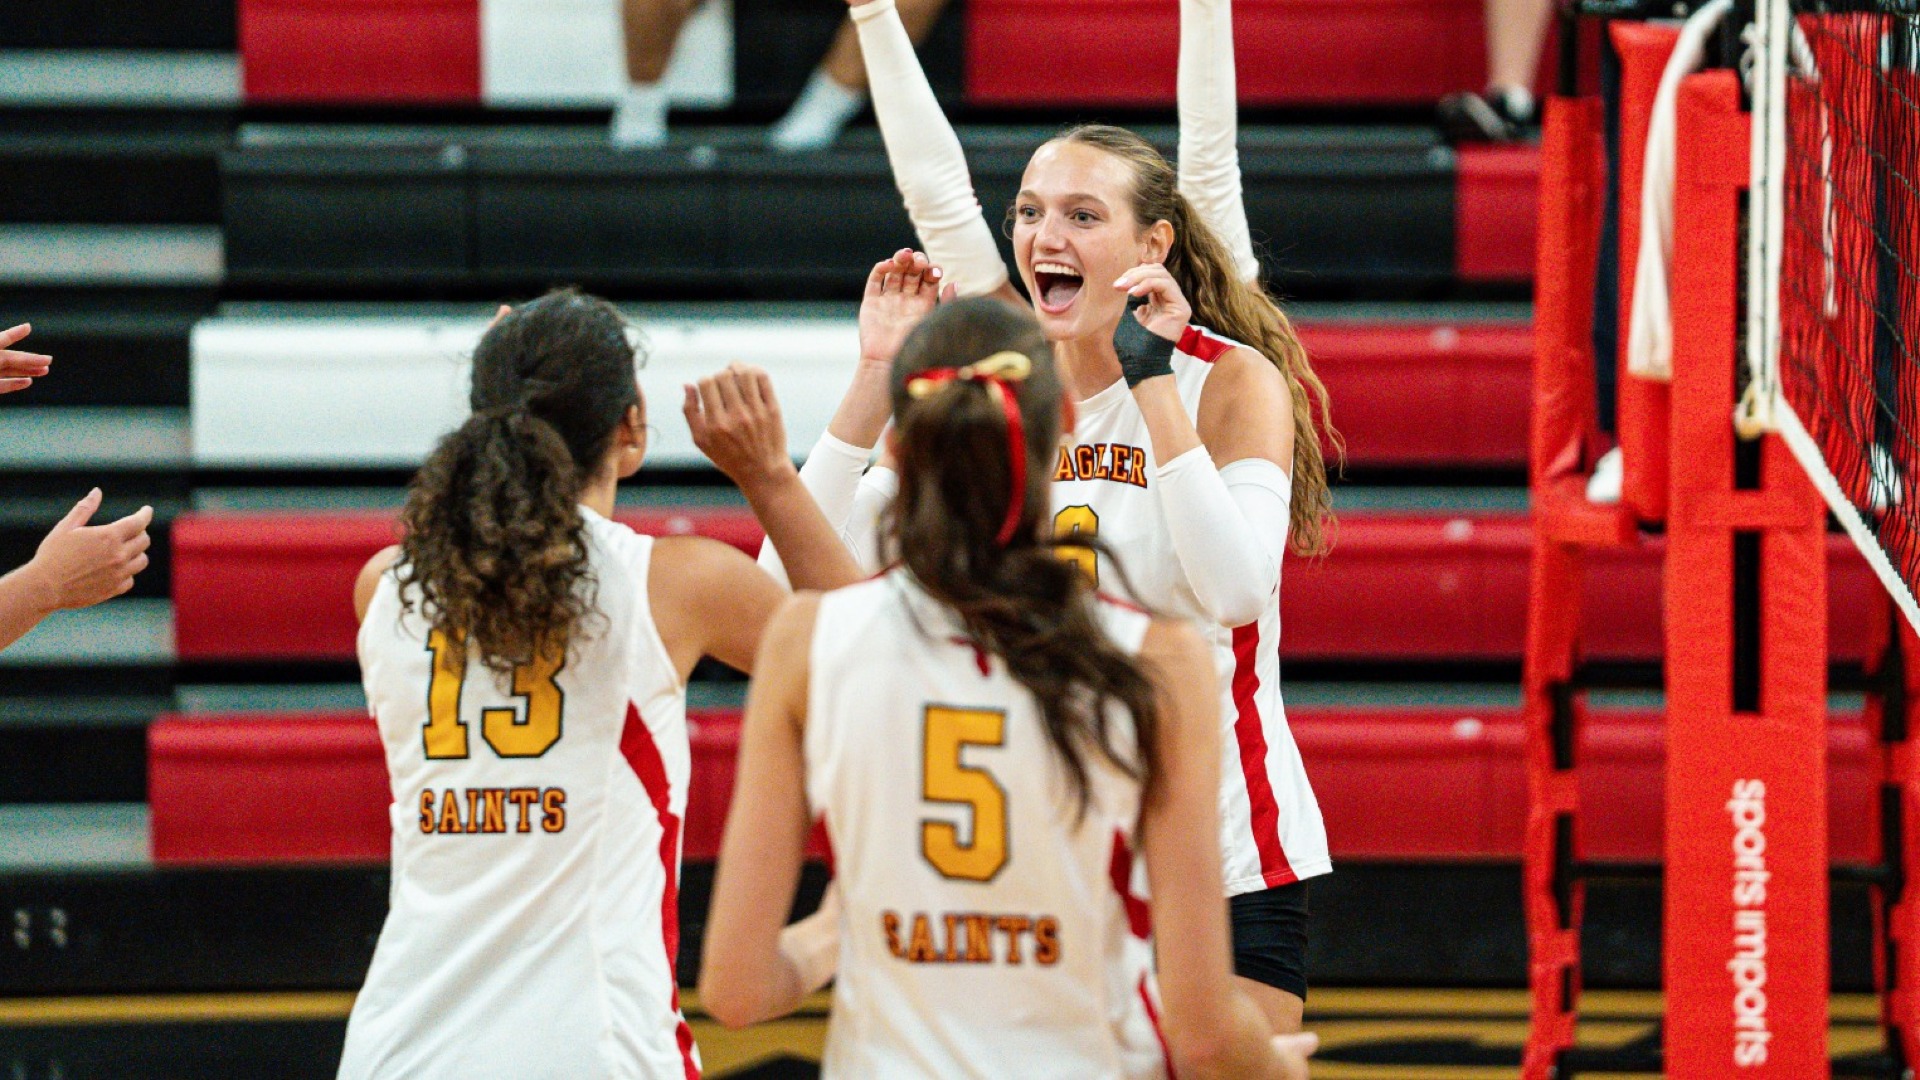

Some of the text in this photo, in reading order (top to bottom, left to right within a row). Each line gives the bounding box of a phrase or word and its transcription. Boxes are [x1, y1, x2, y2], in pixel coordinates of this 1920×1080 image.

[1052, 443, 1148, 488] AGLER
[423, 627, 567, 760] 13
[419, 787, 567, 834] SAINTS
[920, 703, 1010, 883] 5
[882, 909, 1062, 966] SAINTS
[1725, 778, 1773, 1067] sports imports
